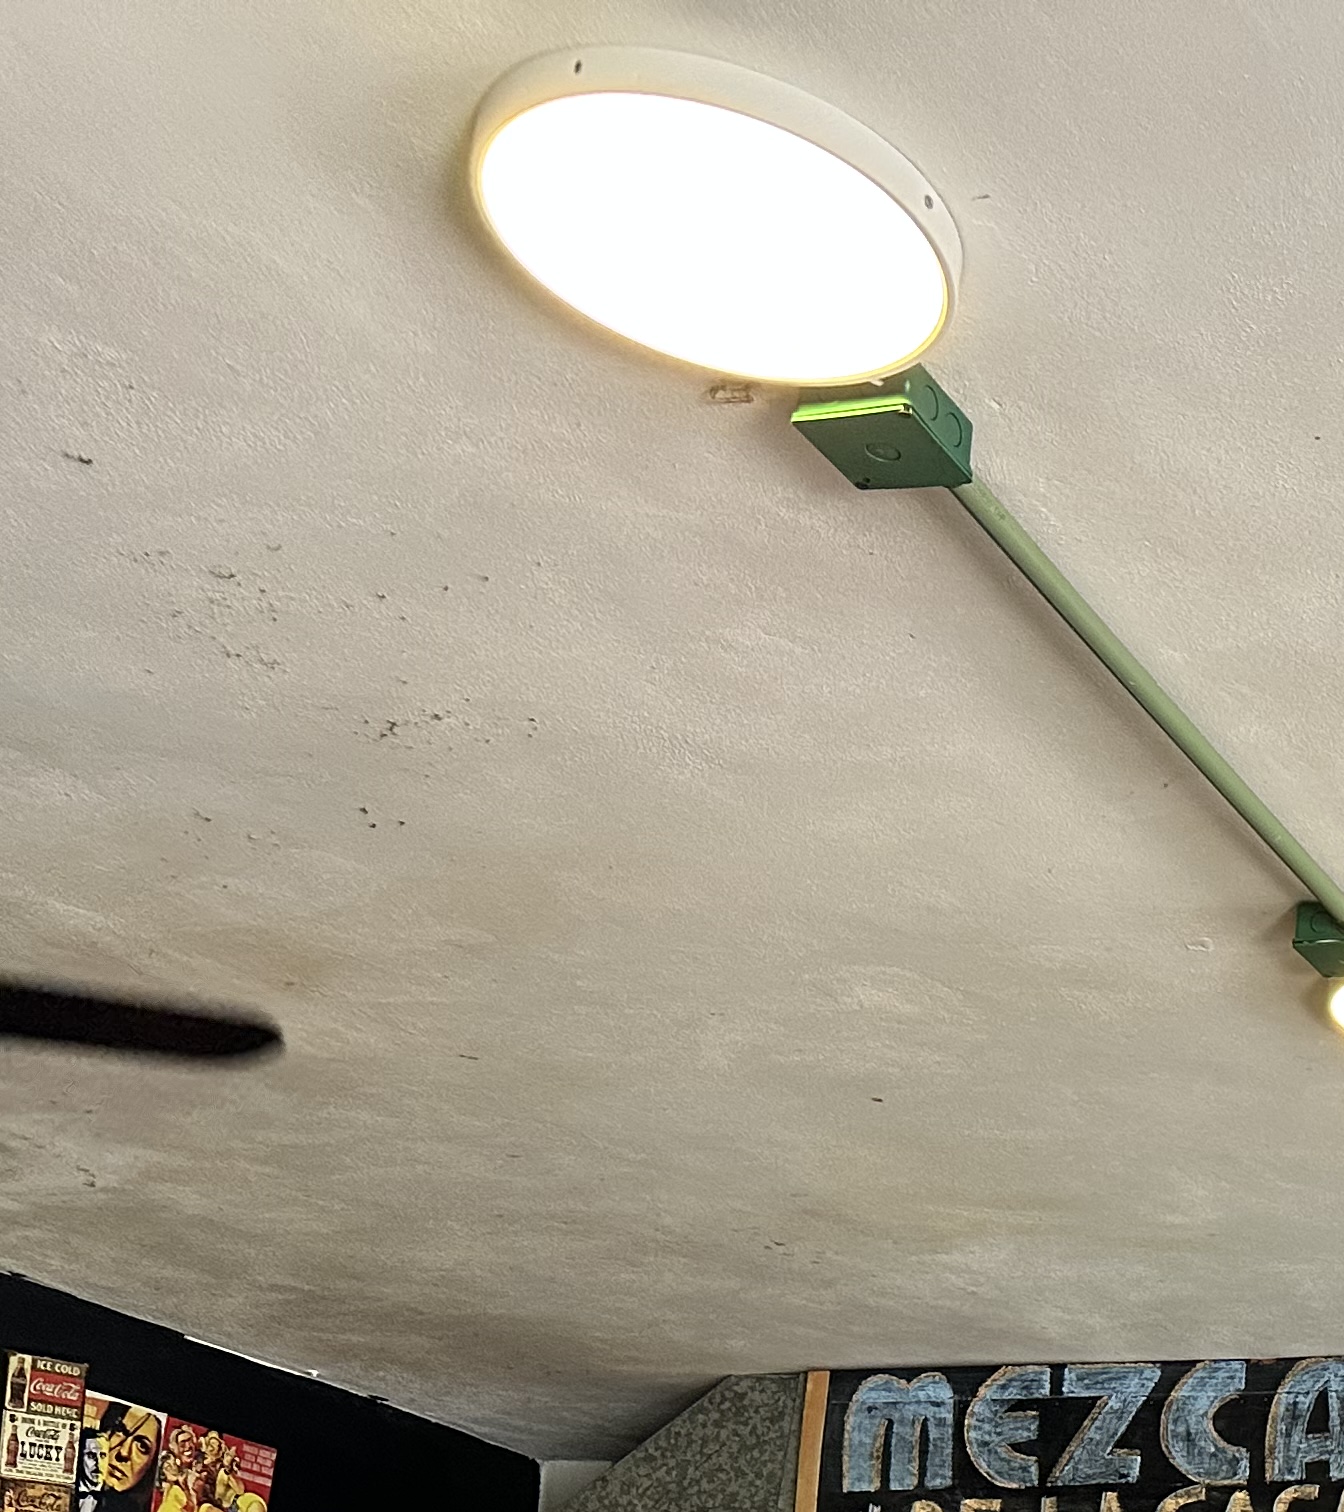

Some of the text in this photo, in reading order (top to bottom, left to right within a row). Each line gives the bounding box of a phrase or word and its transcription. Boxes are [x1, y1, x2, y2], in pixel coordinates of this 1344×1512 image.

[36, 1359, 81, 1376] ICE COLD
[30, 1401, 53, 1414] SOLD
[19, 1440, 64, 1462] LUCKY
